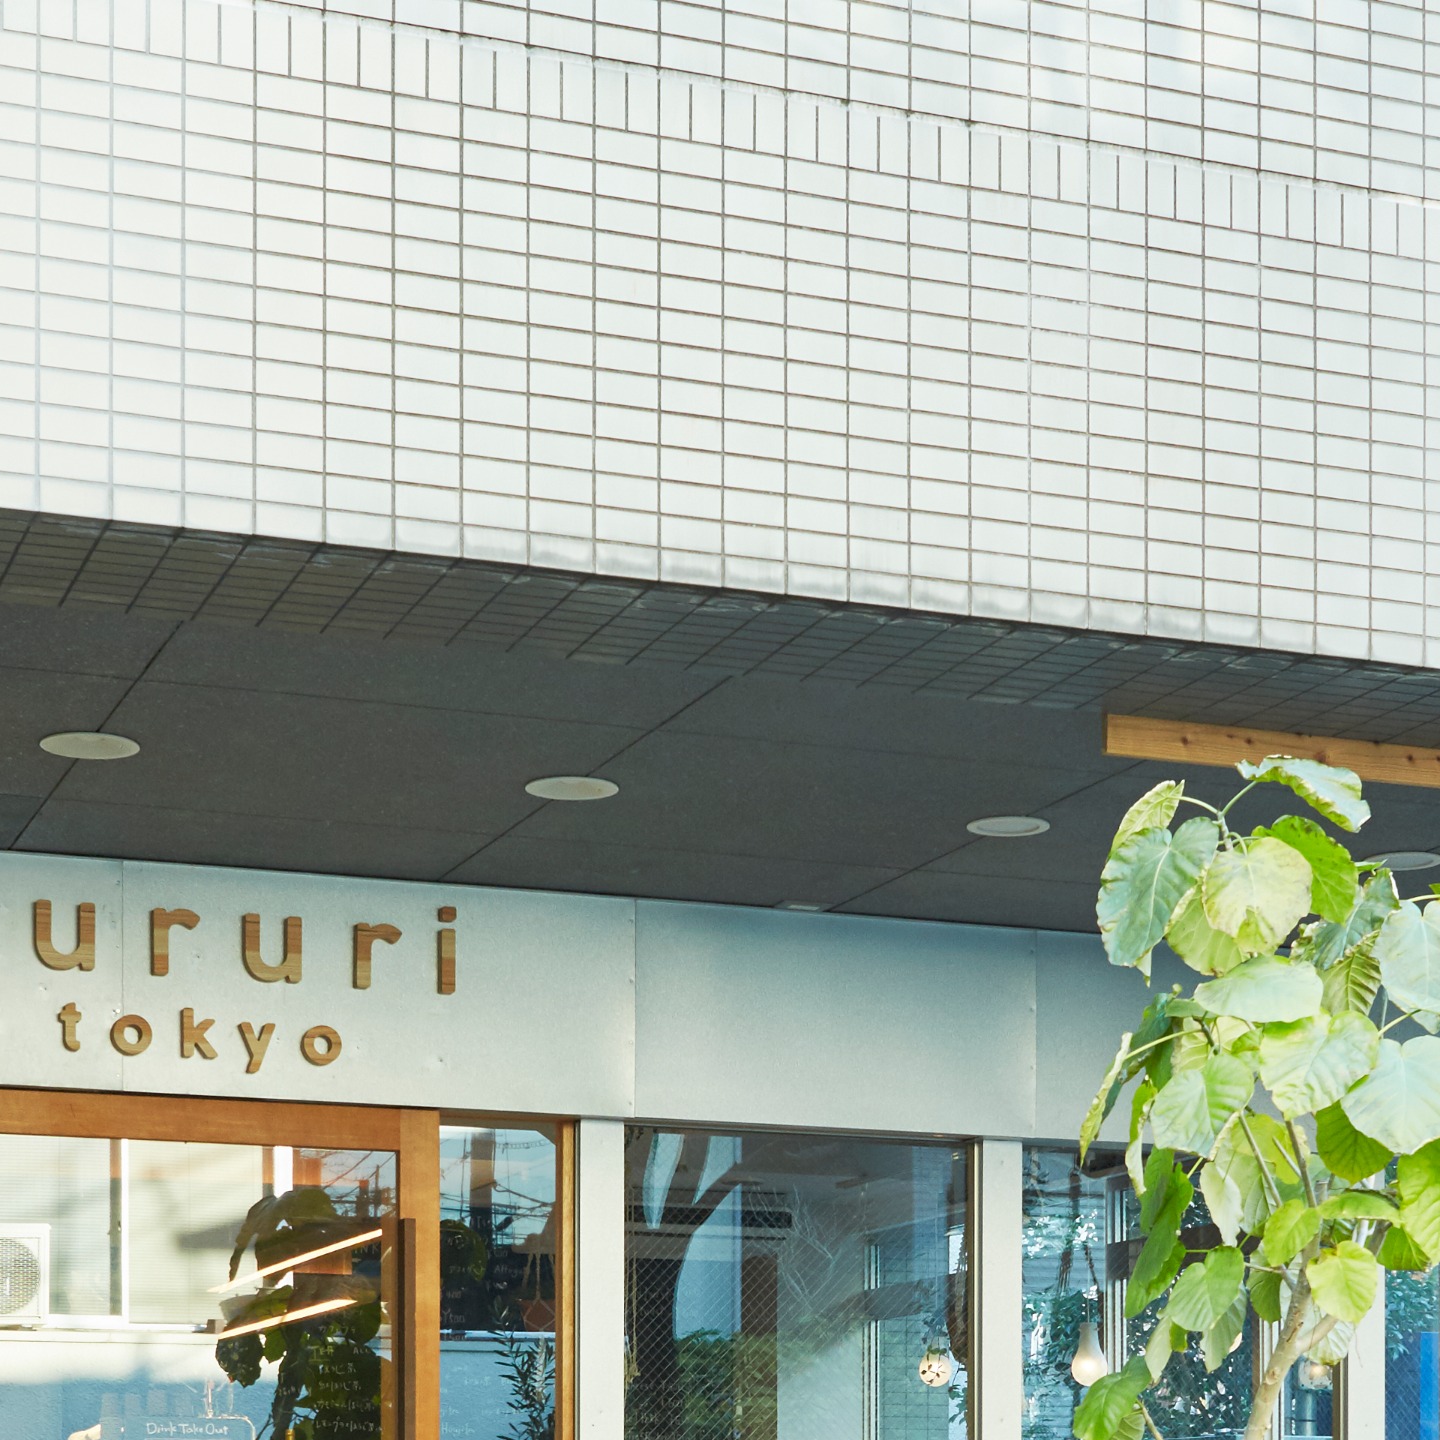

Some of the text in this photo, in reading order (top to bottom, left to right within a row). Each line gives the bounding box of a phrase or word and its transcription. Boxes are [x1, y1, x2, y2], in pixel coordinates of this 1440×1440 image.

[58, 1002, 342, 1074] tokyo
[146, 1421, 230, 1437] Drink Take Out
